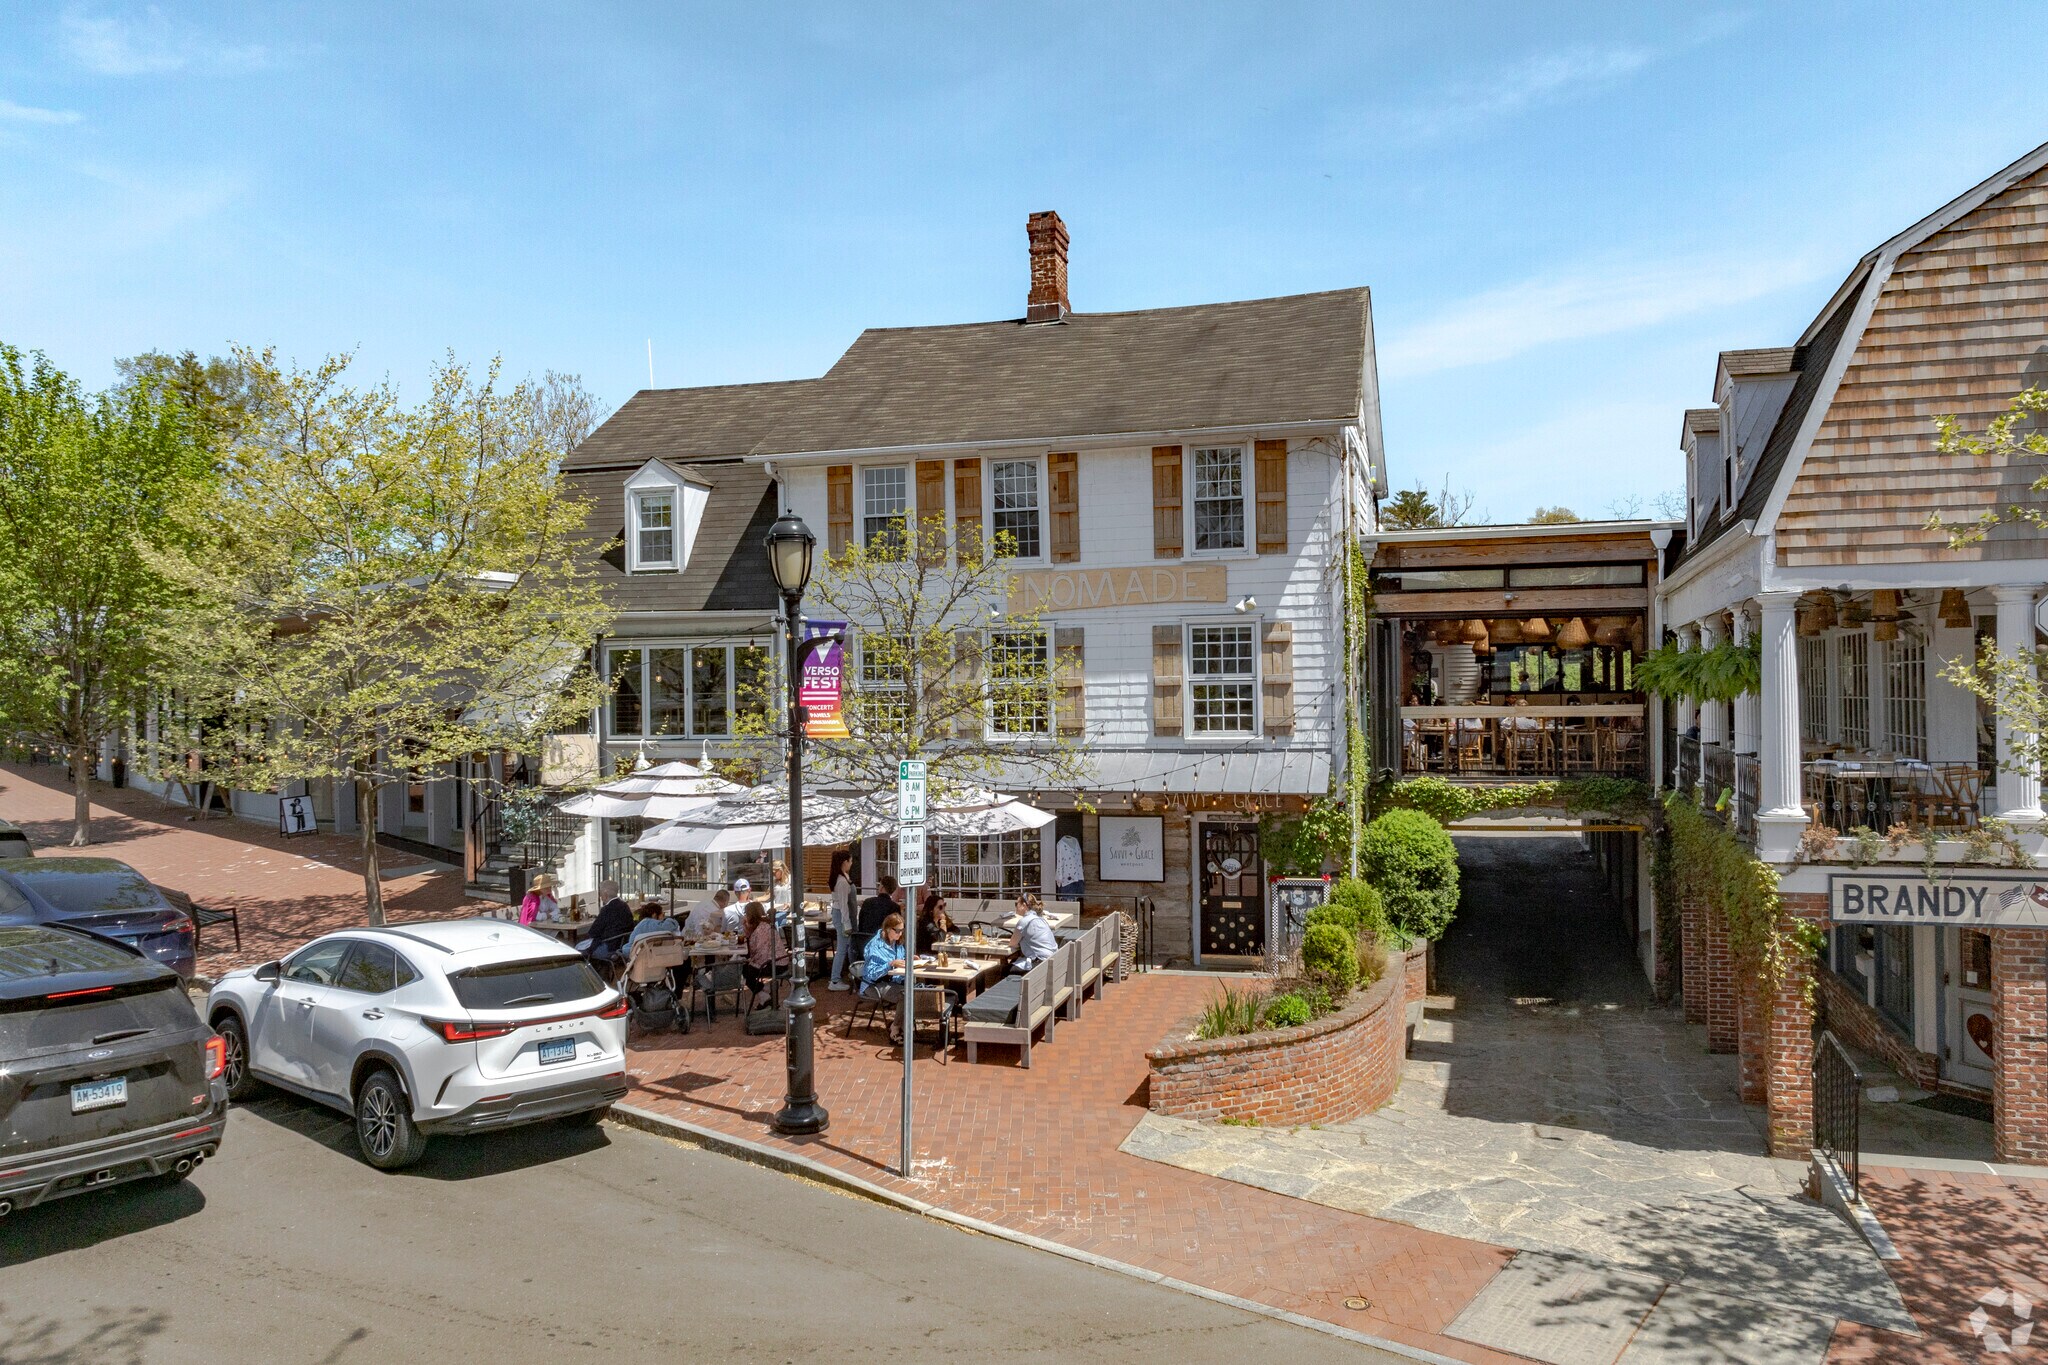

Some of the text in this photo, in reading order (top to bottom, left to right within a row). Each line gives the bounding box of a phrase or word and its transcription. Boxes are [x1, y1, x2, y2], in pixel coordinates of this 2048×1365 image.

[1024, 567, 1207, 608] NOMADE
[804, 666, 840, 676] VERSO
[803, 677, 839, 689] FEST
[902, 765, 907, 776] 3
[905, 782, 920, 791] 8 AM
[909, 794, 917, 803] TO
[905, 806, 920, 815] 6 PM
[903, 835, 921, 844] DO NOT
[904, 851, 919, 860] BLOCK
[900, 867, 923, 877] DRIVEWAY
[942, 866, 957, 883] HER
[980, 865, 1000, 883] BABY
[1843, 883, 1988, 918] BRANDY
[536, 1021, 584, 1033] LEXUS
[77, 1084, 123, 1103] AM-53419
[192, 1094, 206, 1105] ST
